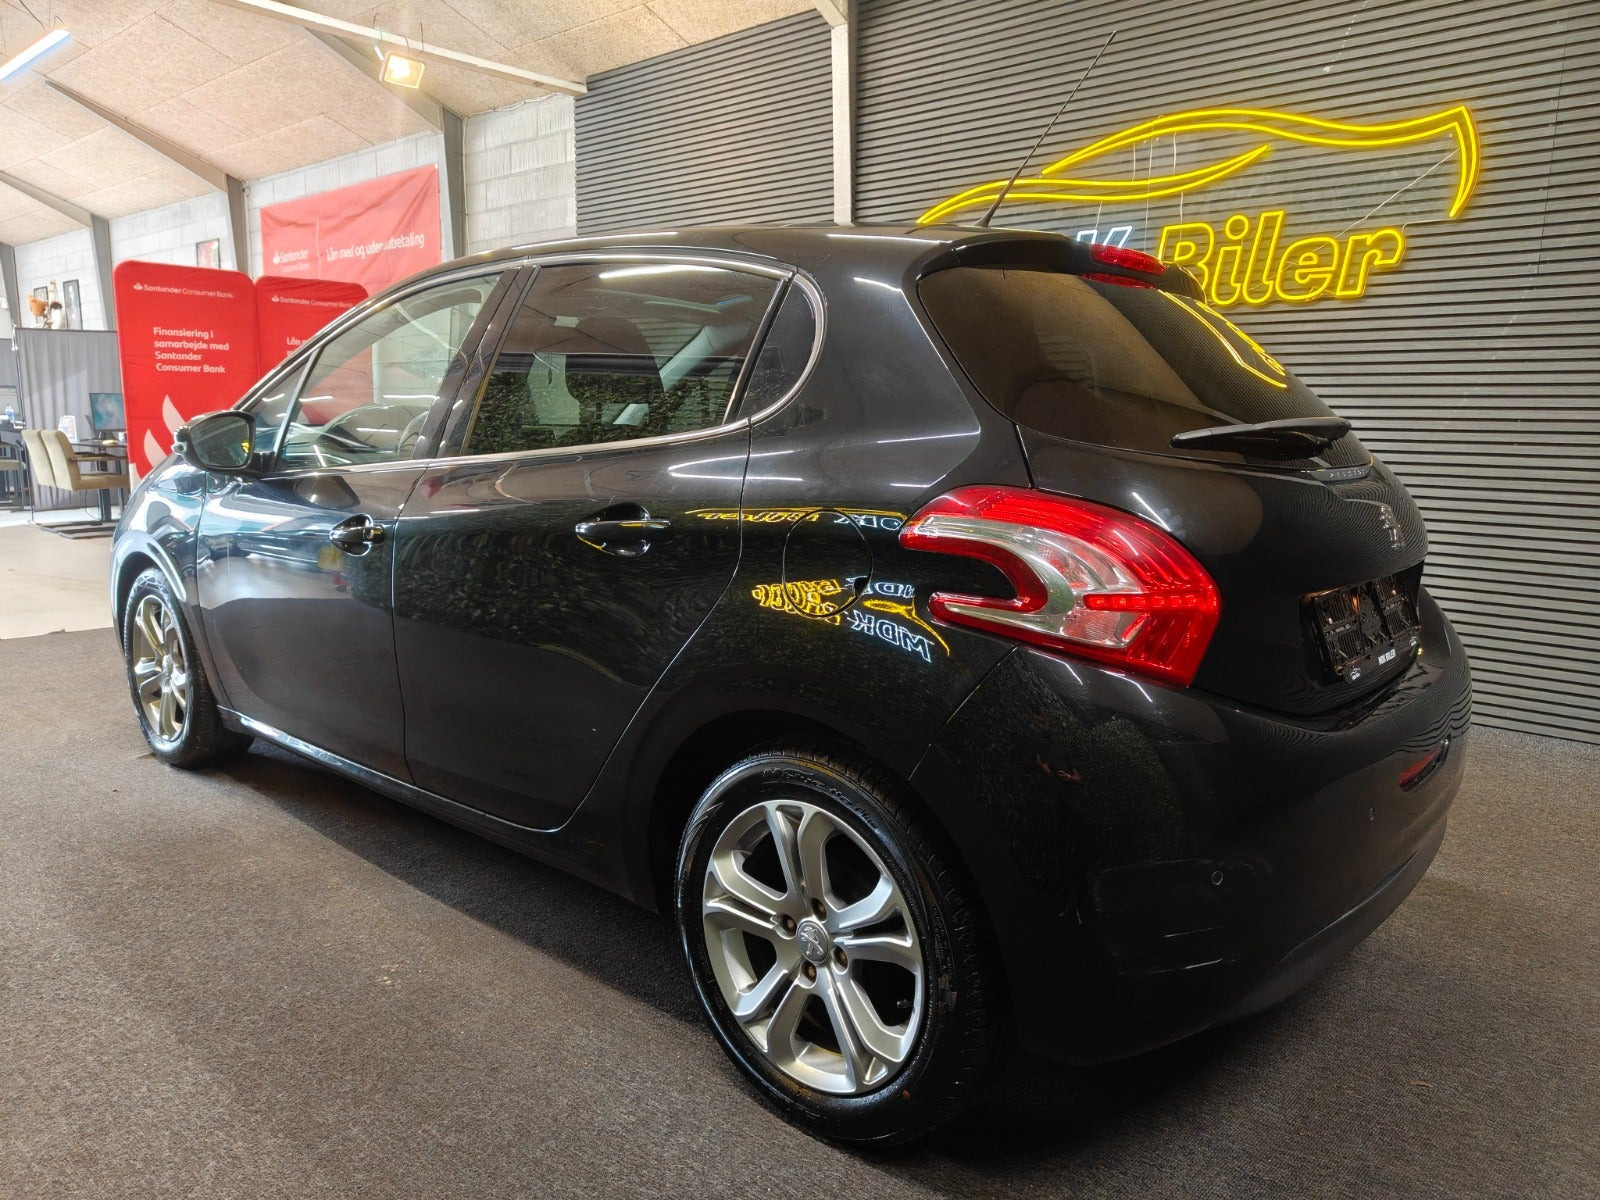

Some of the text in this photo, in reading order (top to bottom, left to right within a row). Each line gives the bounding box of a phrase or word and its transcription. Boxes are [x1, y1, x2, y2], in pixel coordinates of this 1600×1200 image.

[339, 243, 355, 259] med
[355, 244, 366, 260] og
[1157, 208, 1404, 306] Biler
[143, 284, 234, 299] Santander Consumer Bank
[153, 327, 209, 340] Finansiering
[154, 339, 230, 352] samarbejde med
[155, 351, 202, 361] Santander
[156, 363, 226, 374] Consumer Bank
